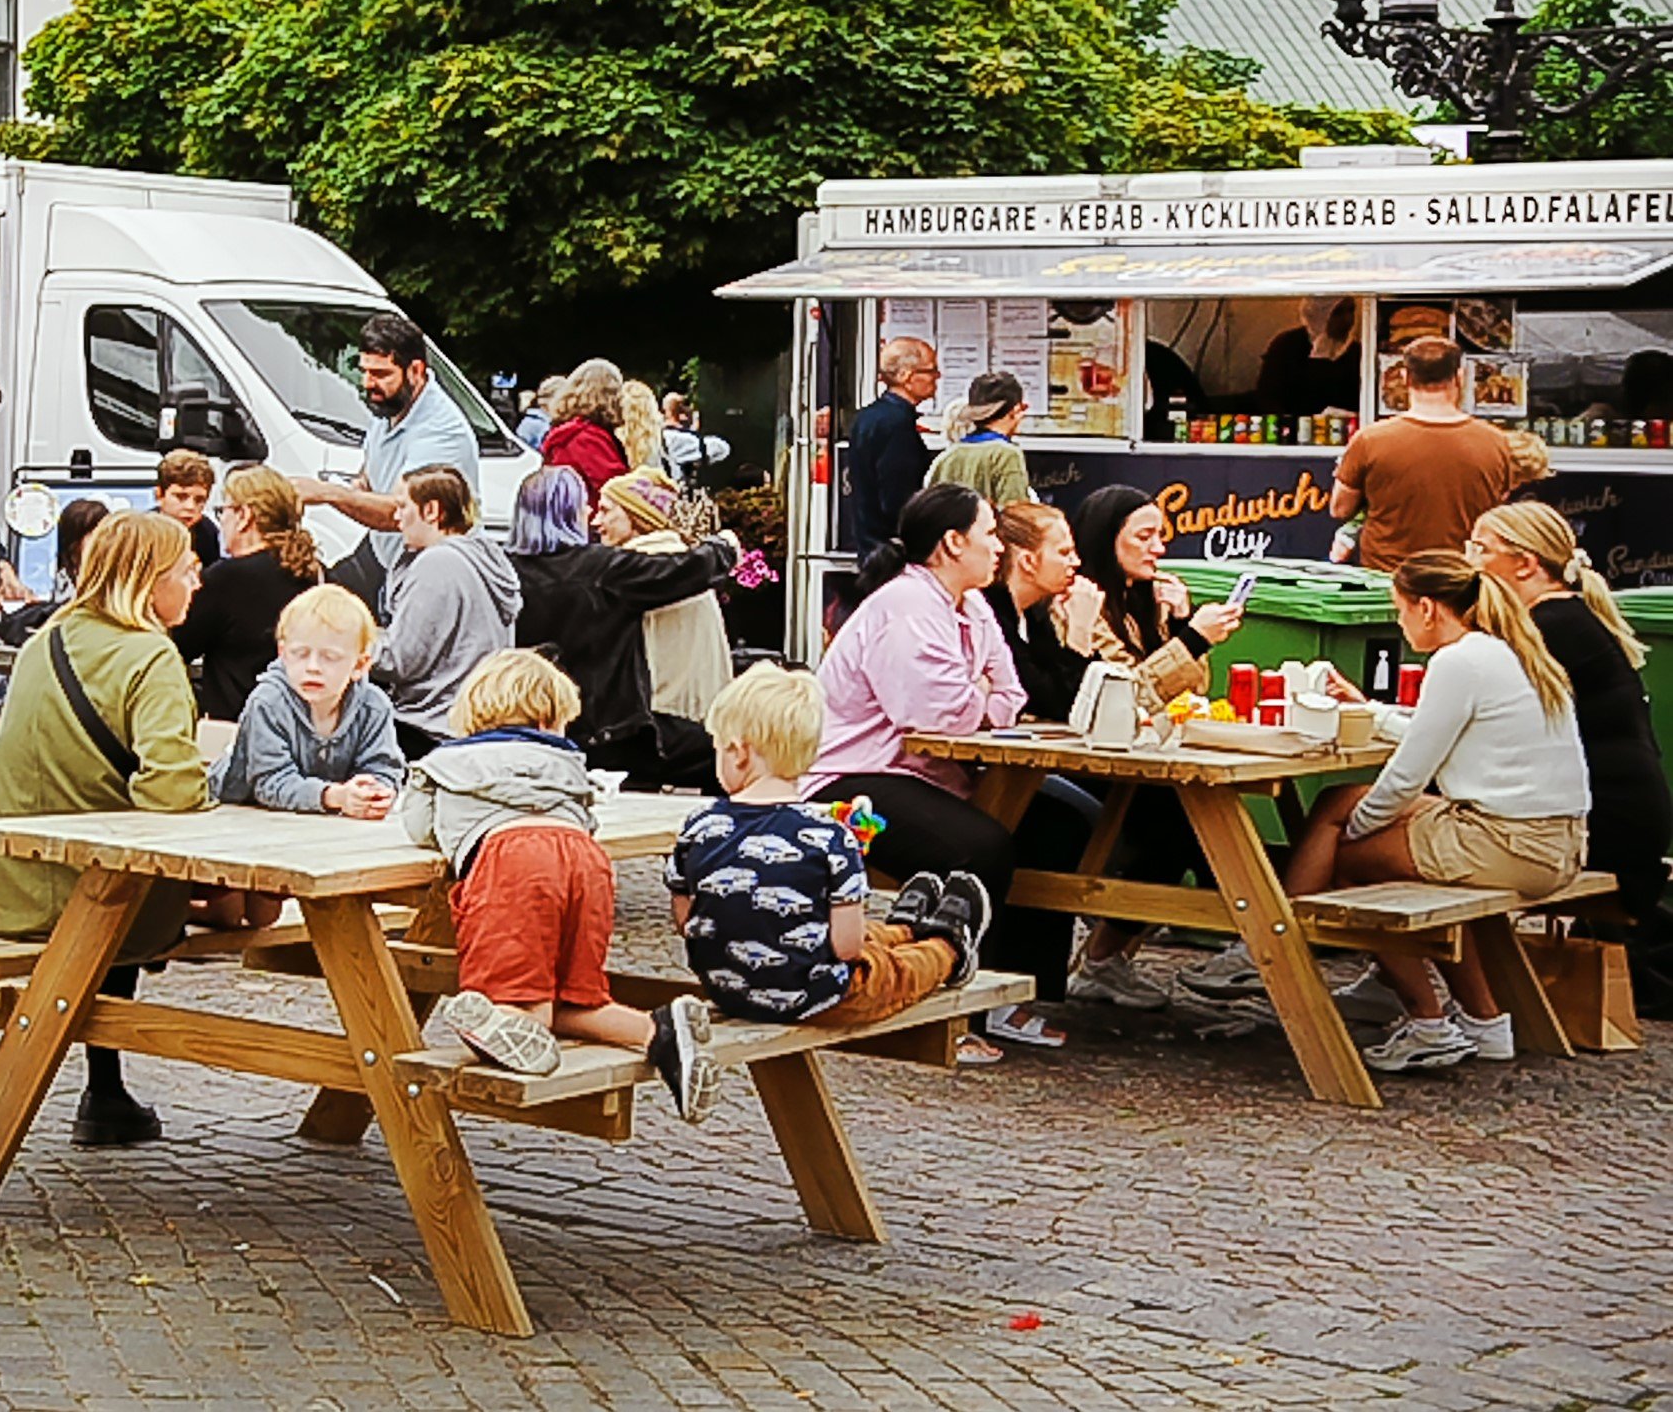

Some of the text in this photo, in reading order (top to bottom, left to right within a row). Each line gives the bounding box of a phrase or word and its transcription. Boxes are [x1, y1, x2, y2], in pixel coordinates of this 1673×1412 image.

[864, 205, 1037, 235] HAMBURGARE
[1060, 203, 1144, 231] KEBAB
[1166, 197, 1396, 230] KYCKLINGKEBAB
[1156, 472, 1330, 543] Sandwich
[1204, 525, 1271, 563] City
